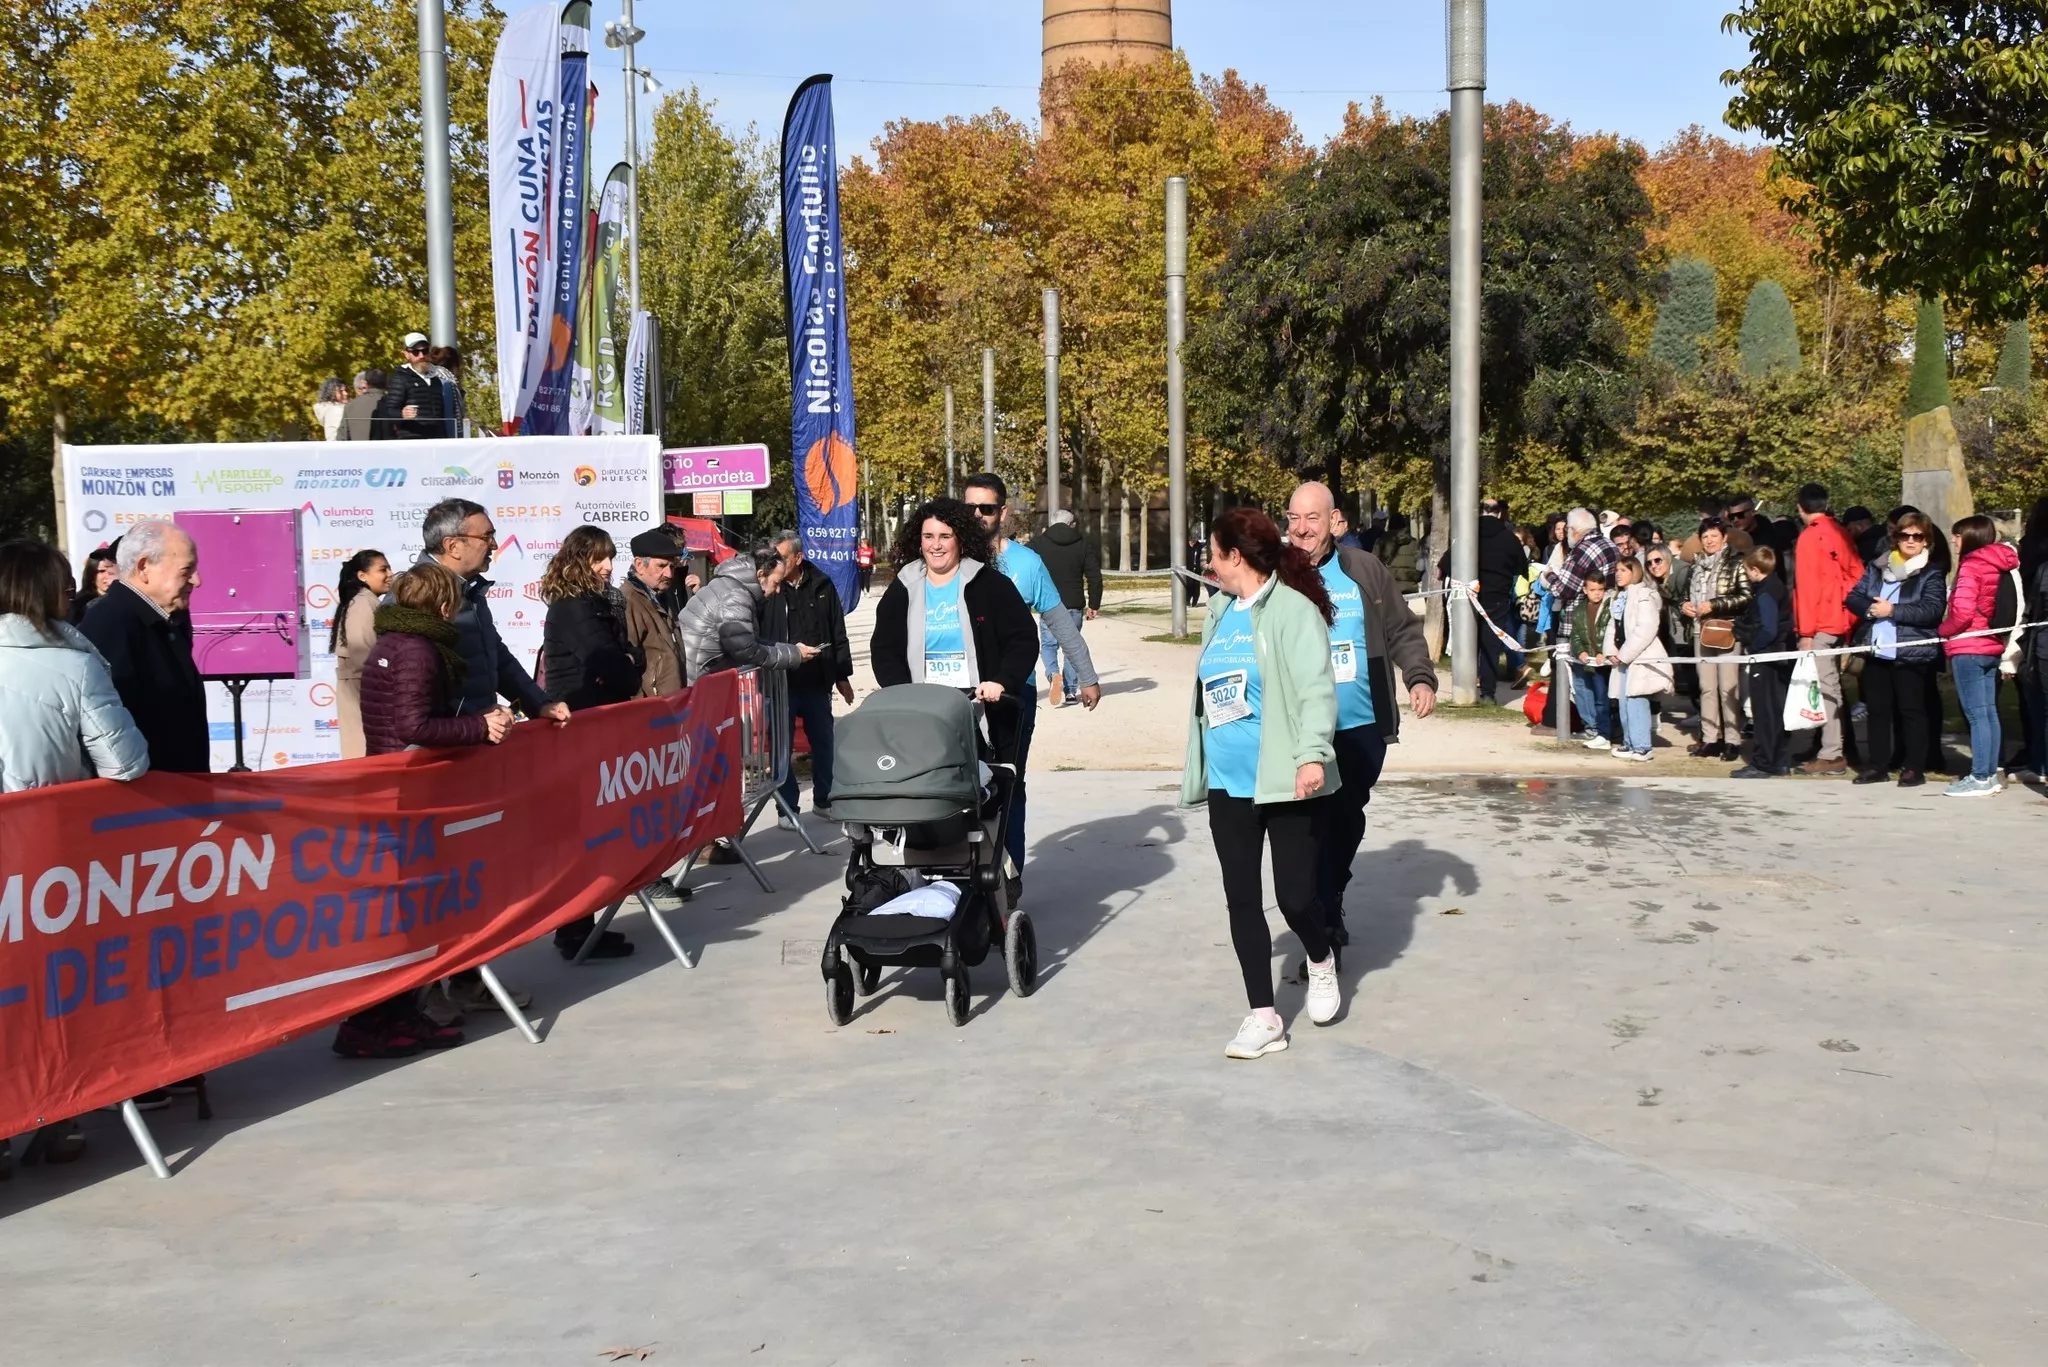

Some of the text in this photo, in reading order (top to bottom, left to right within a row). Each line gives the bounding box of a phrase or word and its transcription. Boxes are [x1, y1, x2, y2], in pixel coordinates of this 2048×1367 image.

[517, 136, 540, 223] CUNA
[563, 208, 573, 230] de
[80, 466, 174, 479] CARRERA EMPRESAS
[297, 467, 363, 478] Empresarios
[519, 470, 560, 480] Monzón
[672, 469, 755, 487] Labordeta
[82, 478, 176, 496] MONZÓN CM
[223, 483, 274, 494] SPORT
[322, 504, 374, 516] alumbra
[574, 501, 637, 510] Automóviles
[496, 506, 562, 518] ESPIAS
[583, 511, 650, 522] CABRERO
[807, 526, 828, 538] 659
[829, 528, 847, 538] 827
[807, 549, 828, 561] 974
[831, 551, 849, 561] 401
[1332, 653, 1349, 664] 18
[929, 661, 961, 673] 3019
[1210, 685, 1238, 704] 3020
[596, 723, 692, 807] MONZÓN
[0, 813, 438, 944] MONZÓN CUNA
[45, 859, 485, 1030] DE DEPORTISTAS
